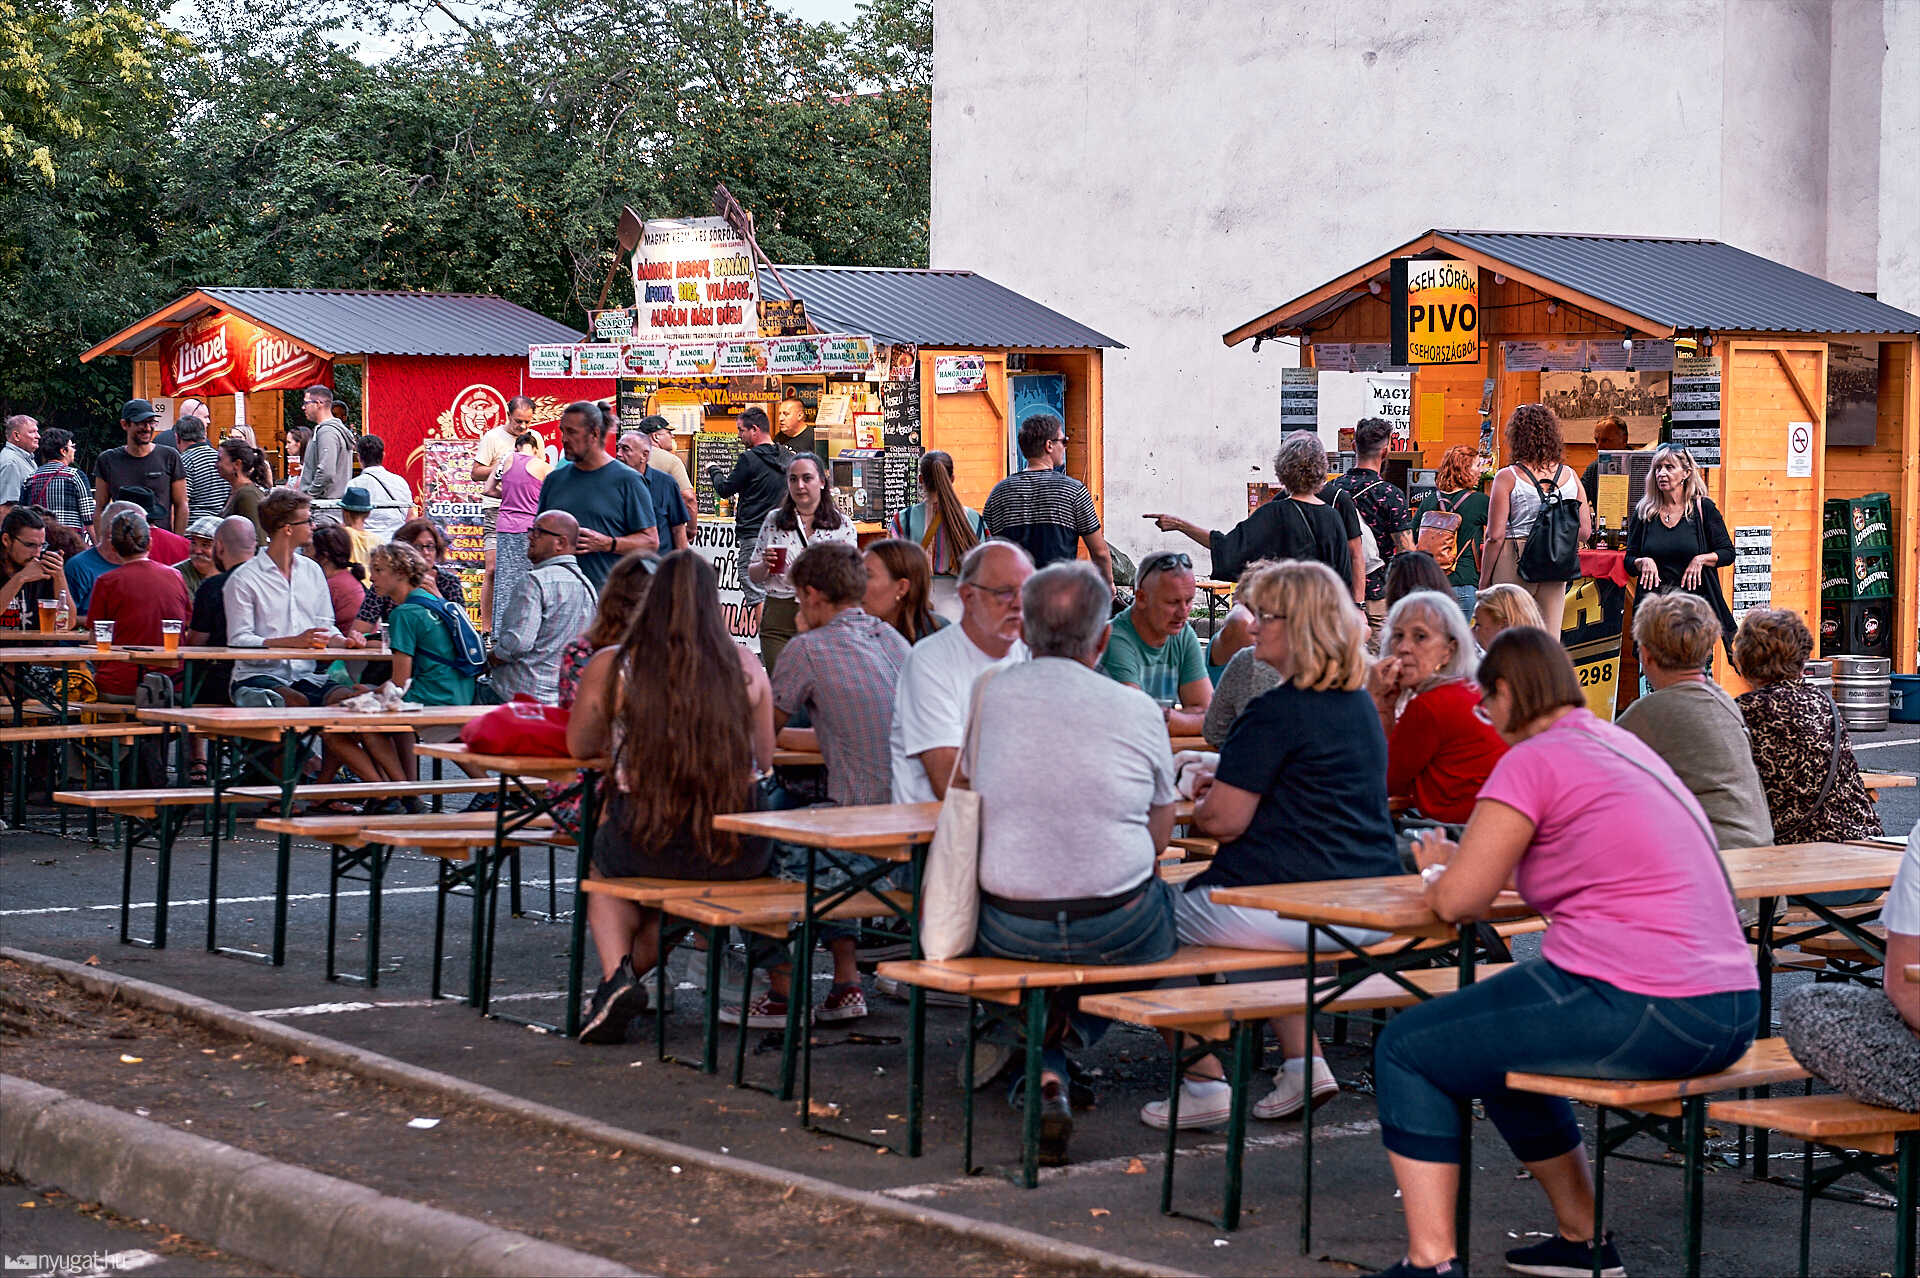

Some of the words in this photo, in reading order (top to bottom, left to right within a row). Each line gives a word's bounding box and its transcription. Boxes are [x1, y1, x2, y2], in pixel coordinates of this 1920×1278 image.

[709, 226, 745, 242] SÖRFŐZ
[713, 252, 754, 280] BANÁN,
[1409, 269, 1435, 294] CSEH
[1440, 264, 1476, 294] SÖRÖK
[706, 278, 754, 301] VILÁGOS,
[596, 319, 632, 328] CSAPOLT
[651, 305, 688, 327] ALFÖLDI
[691, 304, 713, 326] HÁZI
[1409, 304, 1476, 332] PIVO
[177, 324, 229, 384] Litovel
[1409, 339, 1477, 362] CSEHORSZÁGBÓL
[1677, 350, 1693, 359] limo
[255, 336, 304, 382] Litov
[749, 389, 781, 401] PÁLINKA
[799, 390, 819, 401] peps
[1380, 402, 1410, 415] JÉGH
[1395, 418, 1410, 429] ÜV
[447, 524, 484, 535] KÉZM
[1821, 578, 1849, 590] BKOWICZ
